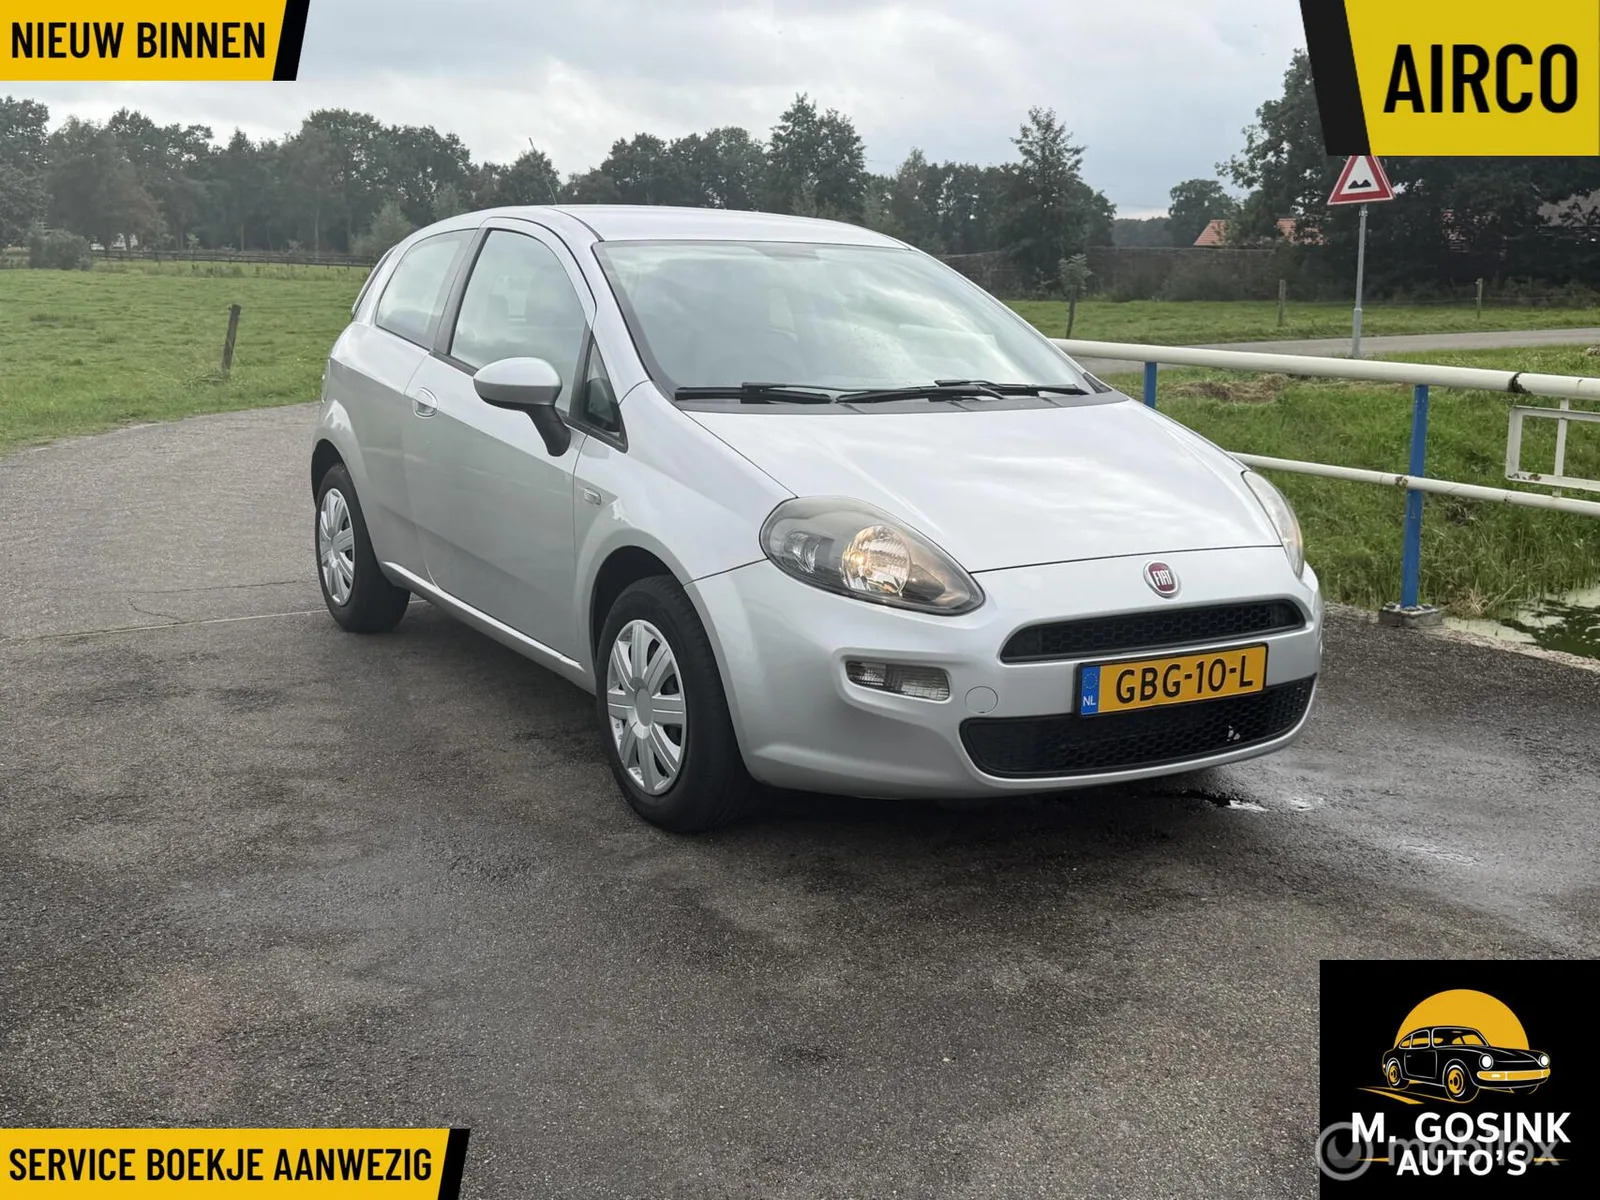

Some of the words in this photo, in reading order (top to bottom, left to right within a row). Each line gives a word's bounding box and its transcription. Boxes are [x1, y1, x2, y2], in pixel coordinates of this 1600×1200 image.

[1152, 569, 1173, 586] FIAT
[1082, 695, 1096, 707] NL
[1115, 655, 1253, 704] GBG-10-L
